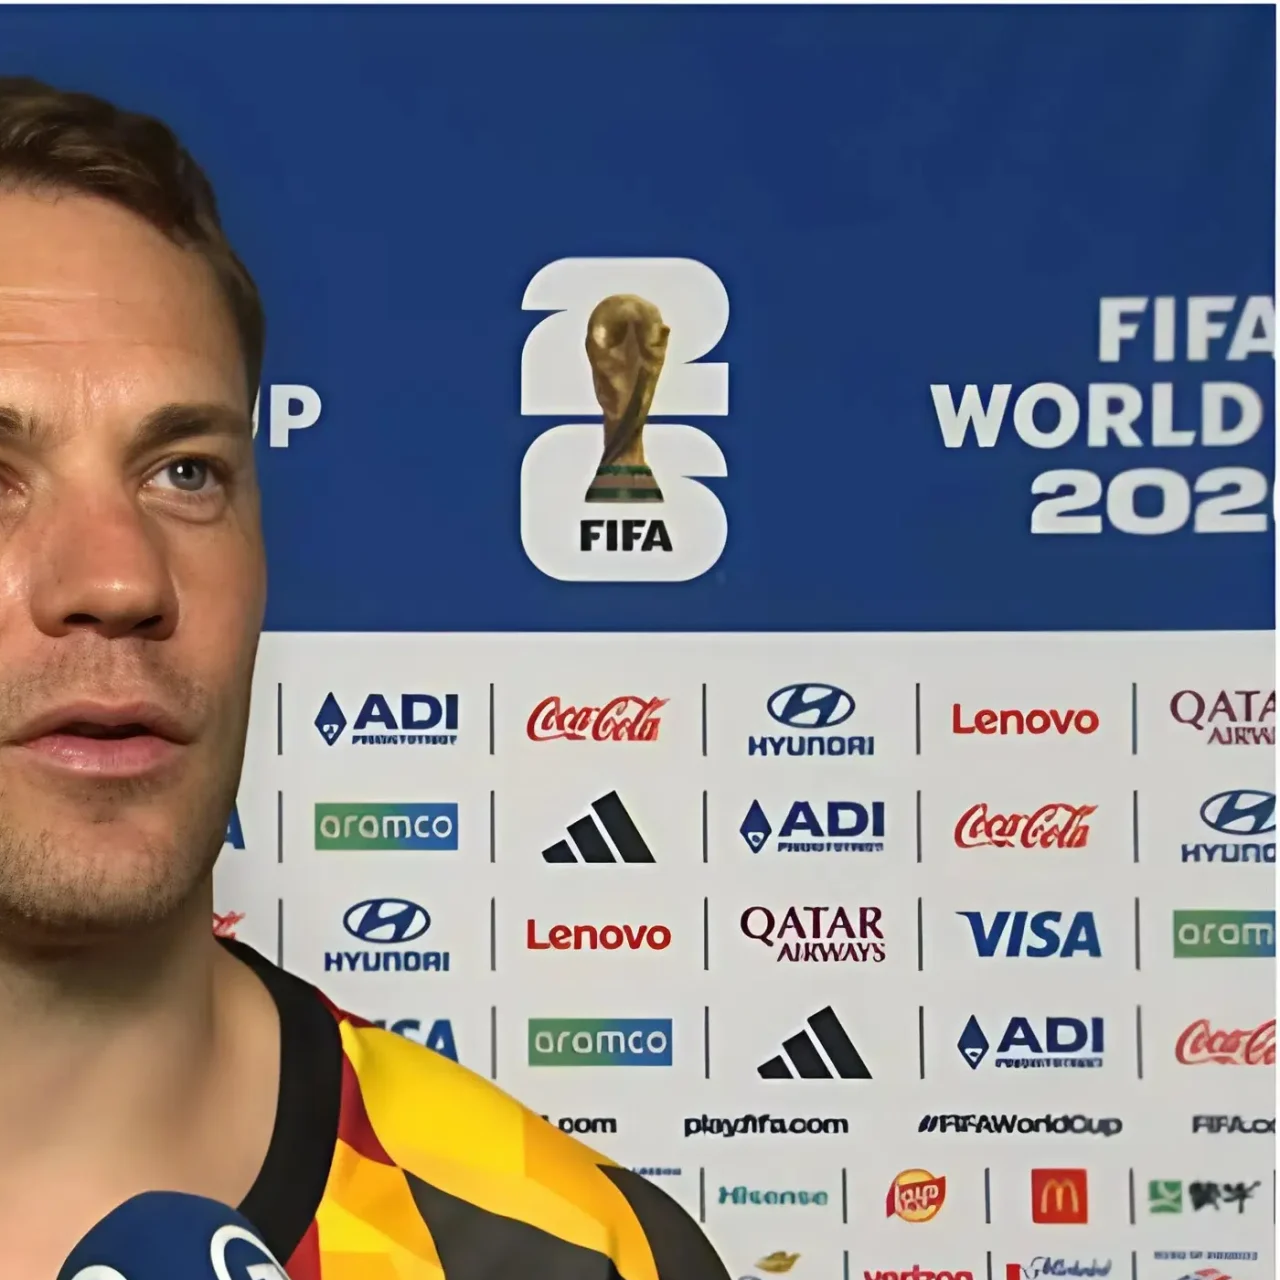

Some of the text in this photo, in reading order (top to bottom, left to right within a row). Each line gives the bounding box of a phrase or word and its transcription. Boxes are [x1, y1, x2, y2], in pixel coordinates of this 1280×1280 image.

[1099, 295, 1275, 362] FIFA
[252, 385, 322, 448] P
[930, 381, 1263, 449] WORLD
[1031, 467, 1275, 535] 202
[580, 519, 673, 552] FIFA
[353, 694, 458, 730] ADI
[953, 703, 1099, 735] Lenovo
[748, 736, 874, 756] HYUNDAI
[321, 816, 453, 839] aramco
[778, 801, 885, 837] ADI
[527, 919, 671, 950] Lenovo
[740, 906, 885, 946] QATAR
[956, 911, 1102, 958] VISA
[324, 951, 449, 972] HYUNDAI
[776, 943, 886, 963] AIRWAYS
[534, 1030, 667, 1055] aramco
[997, 1016, 1104, 1053] ADI
